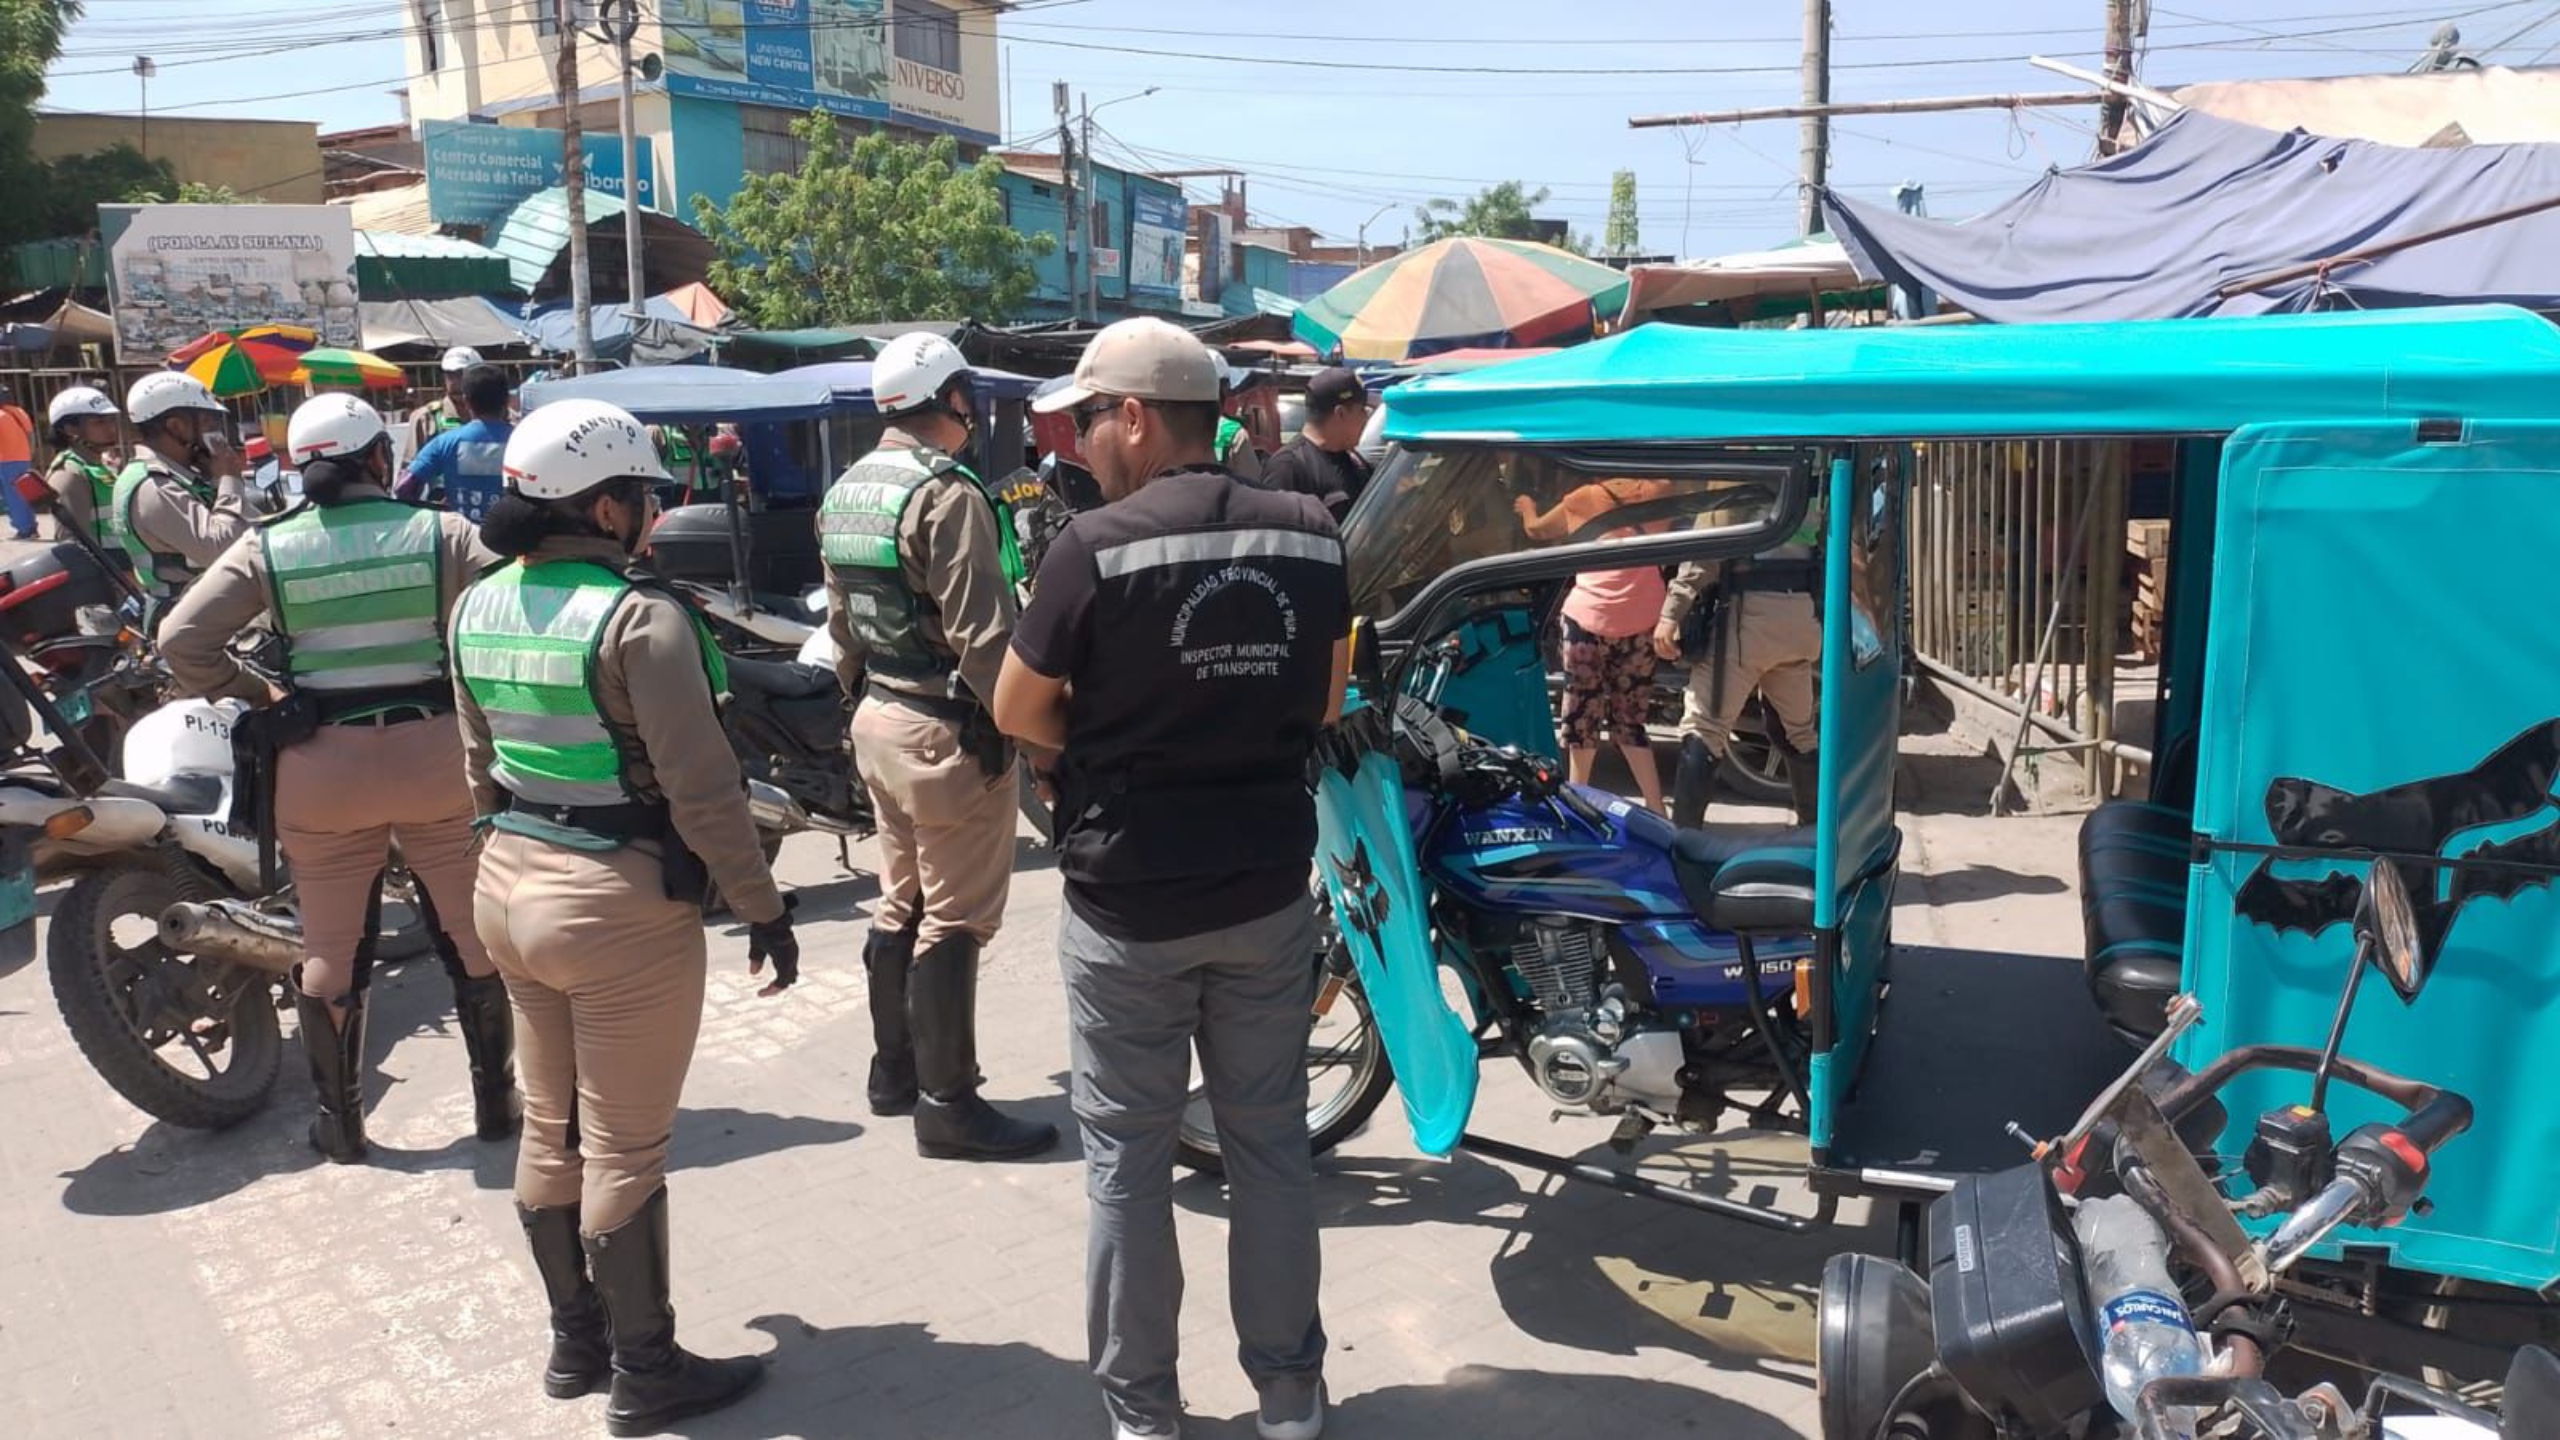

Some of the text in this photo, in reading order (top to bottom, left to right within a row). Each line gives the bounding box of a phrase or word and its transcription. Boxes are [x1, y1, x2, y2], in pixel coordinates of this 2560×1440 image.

[755, 43, 802, 59] UNIVERSO
[750, 54, 809, 72] NEW CENTER
[894, 60, 965, 101] NIVERSO
[433, 149, 543, 169] Centro Comercial
[434, 166, 543, 186] Mercado de Telas
[583, 170, 649, 193] ibano
[565, 416, 636, 453] TRANSITO
[1169, 566, 1297, 647] MUNICIPALIDAD PROVINCIAL DE PIURA
[1181, 643, 1290, 664] INSPECTOR MUNICIPAL
[1196, 662, 1279, 680] DE TRANSPORTE
[1463, 826, 1552, 845] WANXIN
